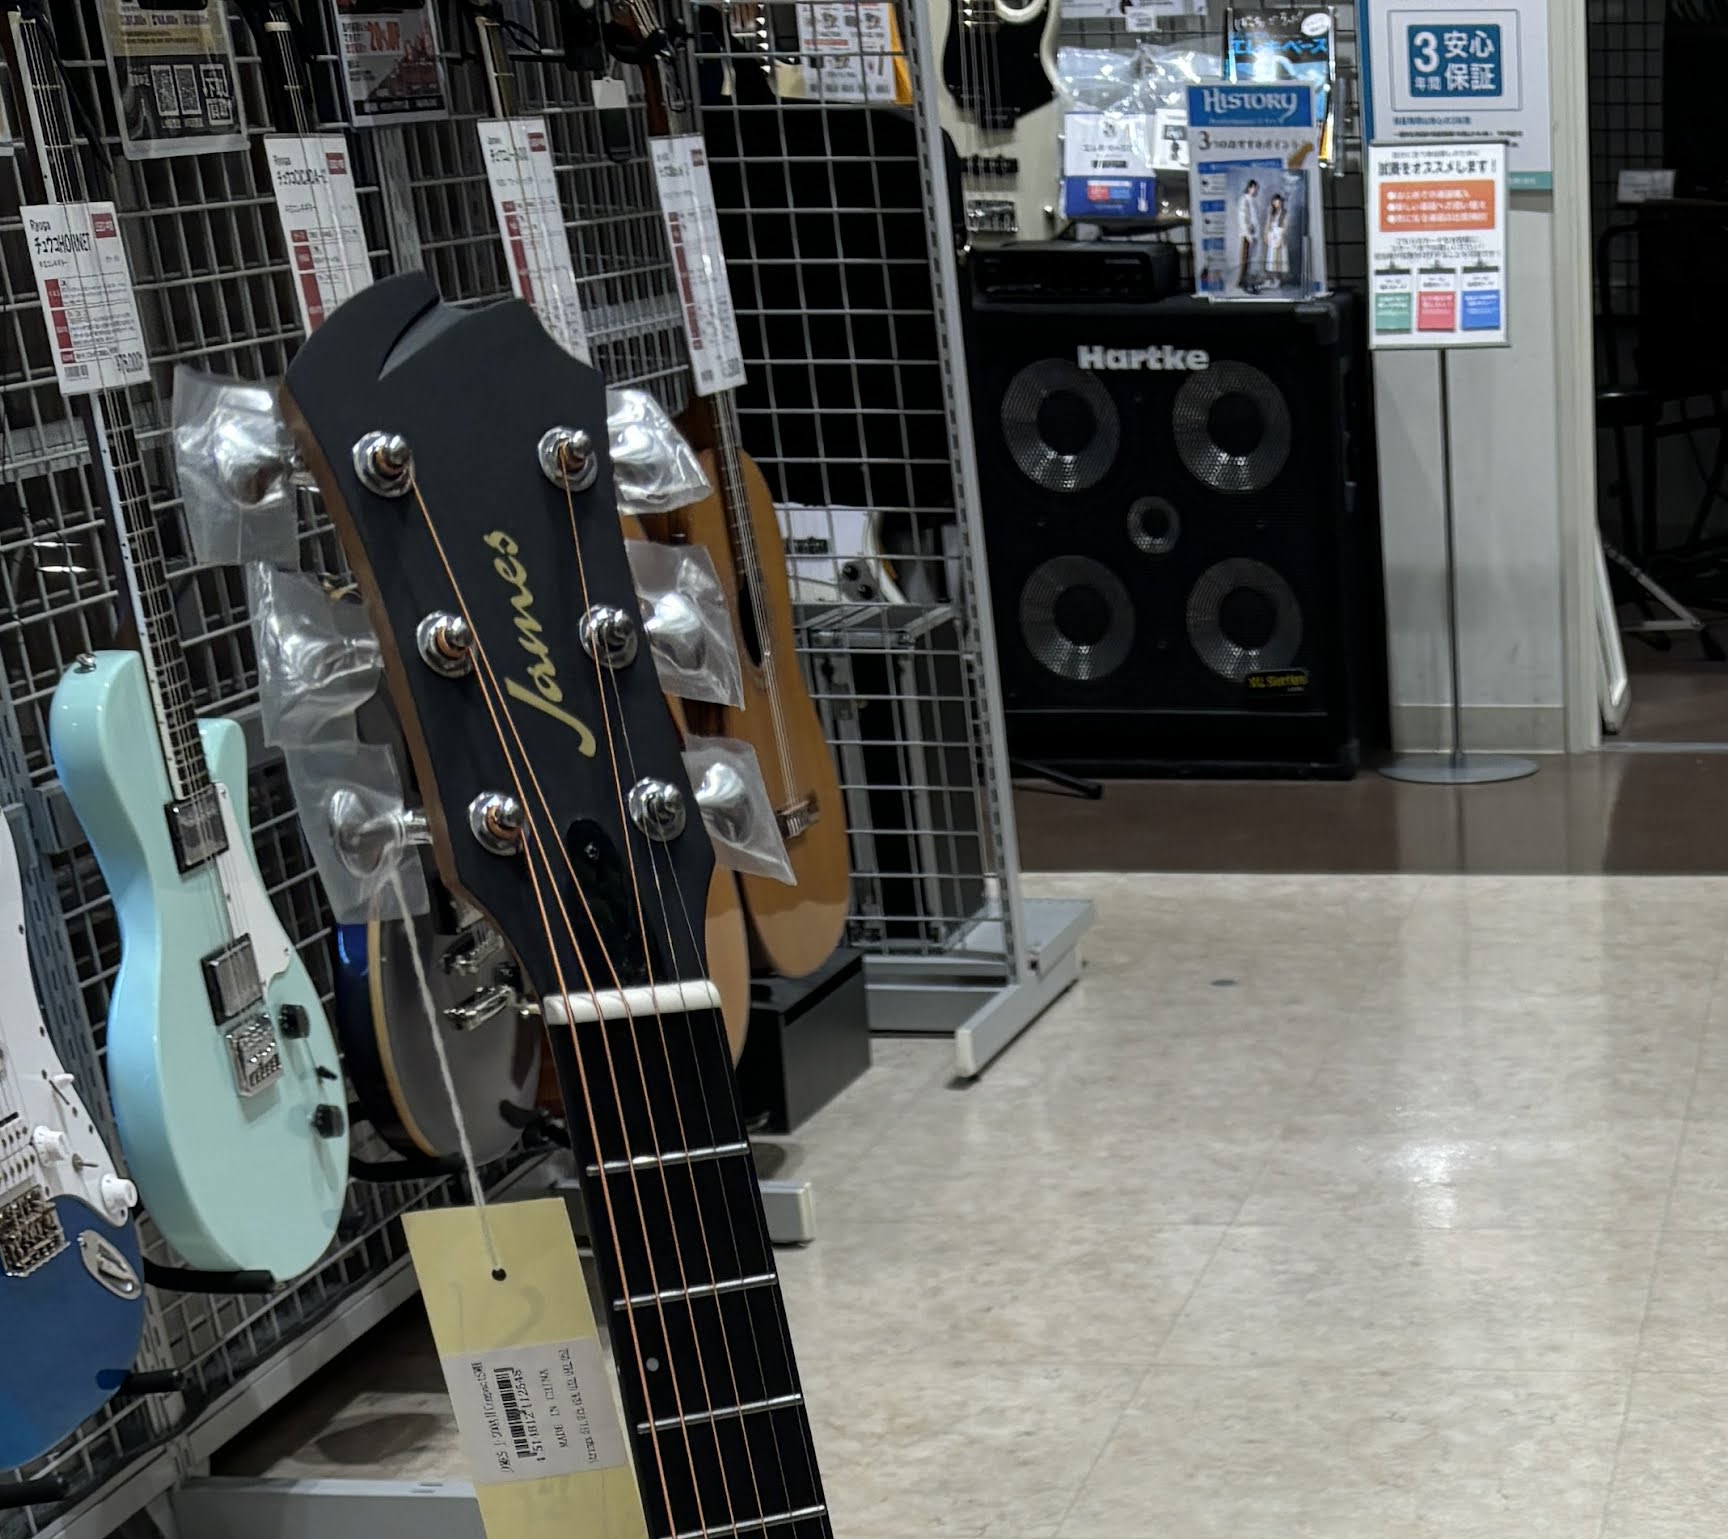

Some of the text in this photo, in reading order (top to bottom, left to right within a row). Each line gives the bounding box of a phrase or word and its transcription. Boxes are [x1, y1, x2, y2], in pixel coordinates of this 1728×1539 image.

[1413, 31, 1440, 73] 3
[1443, 30, 1495, 59] 安心
[1414, 76, 1442, 92] 年間
[1444, 62, 1497, 91] 保証
[1077, 344, 1210, 371] Hartke
[483, 530, 597, 759] James
[540, 1368, 555, 1400] CHINA
[554, 1424, 569, 1448] MADE
